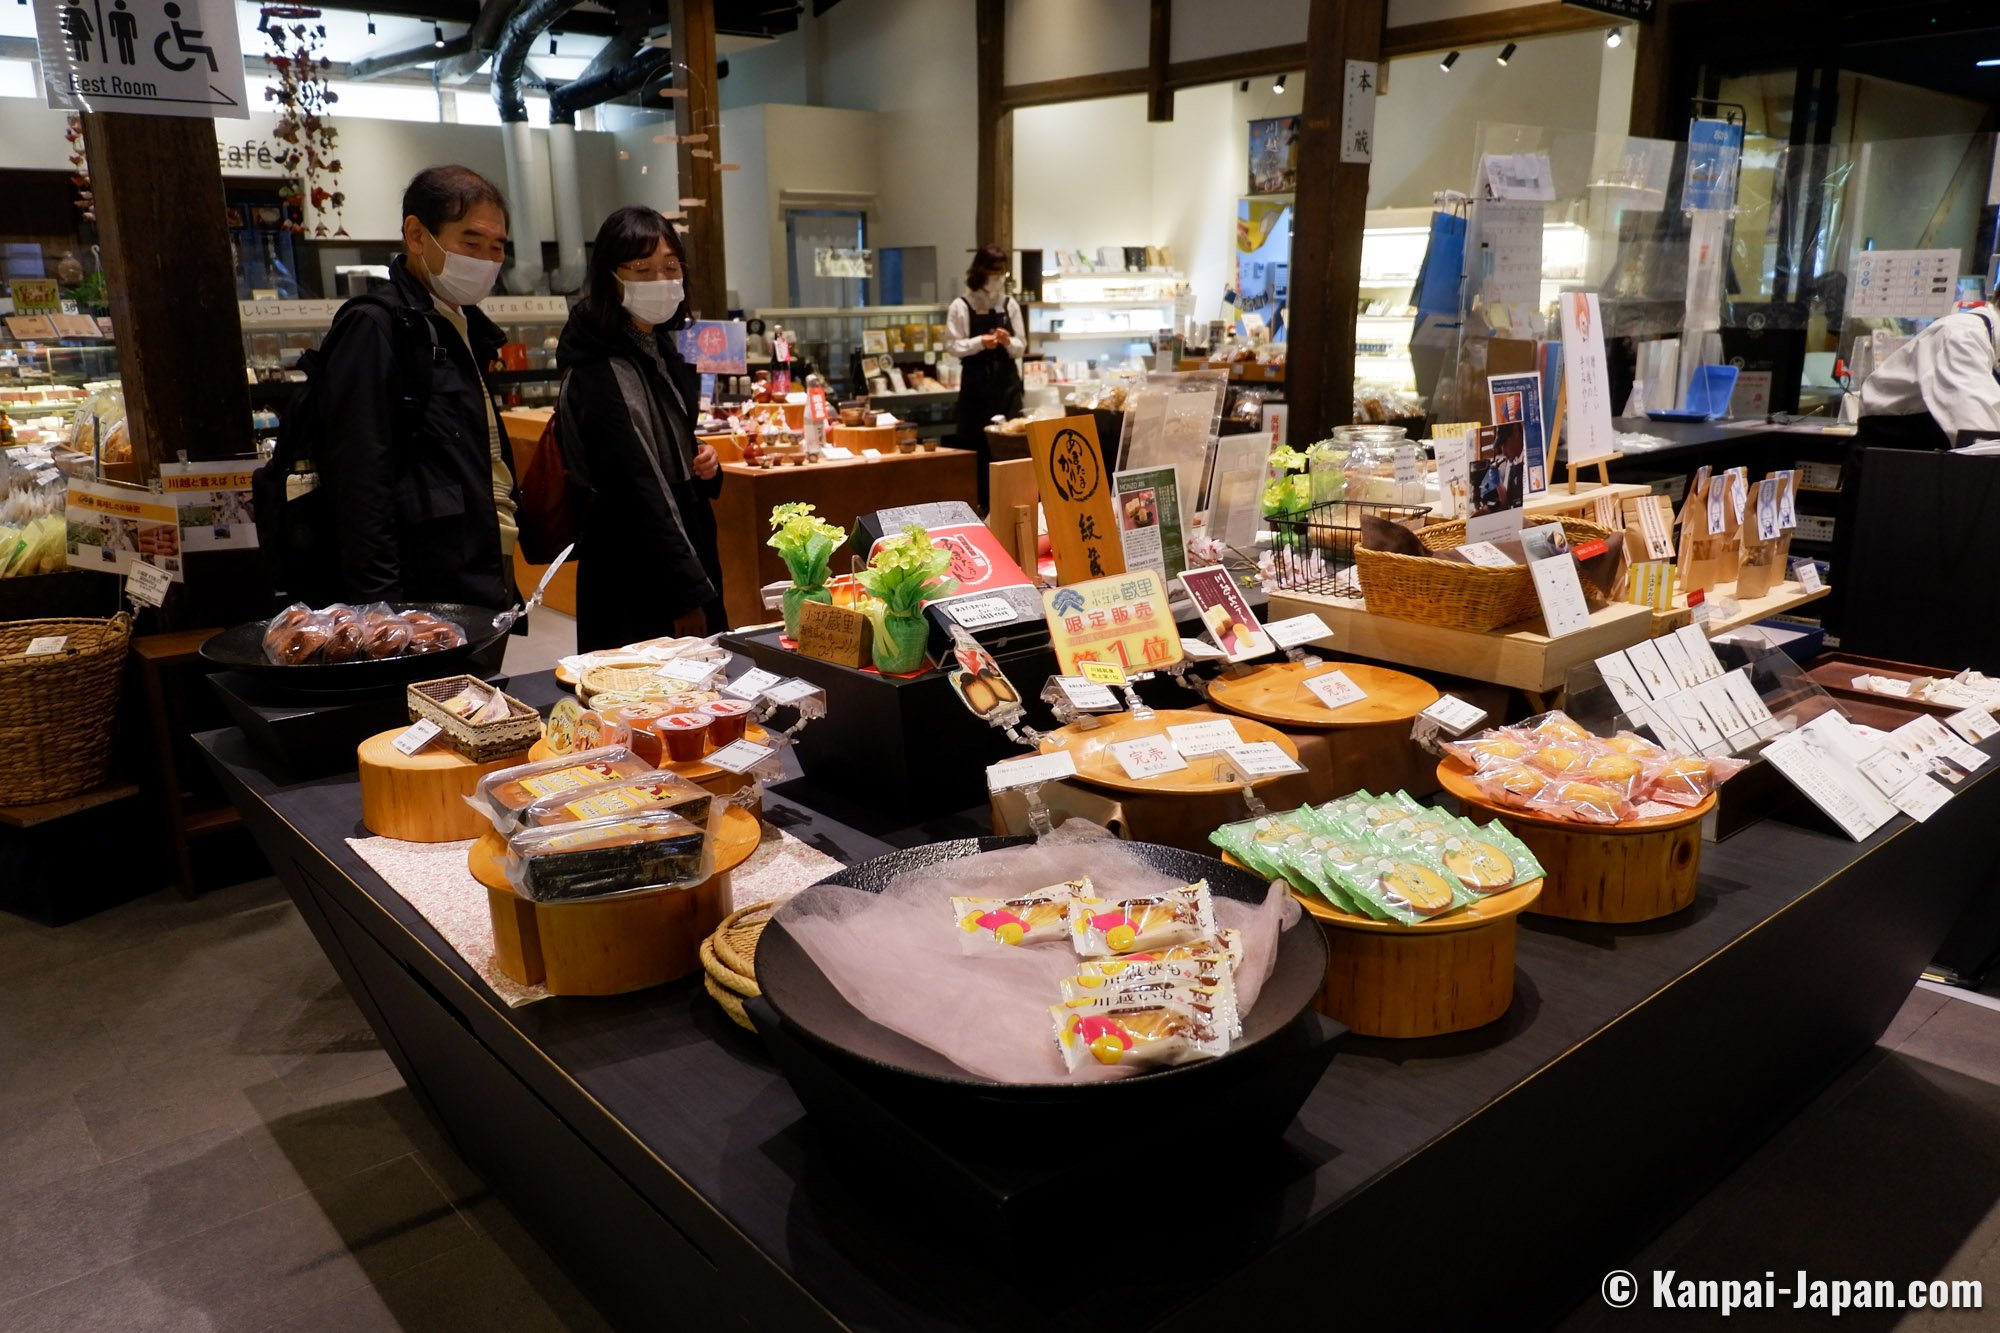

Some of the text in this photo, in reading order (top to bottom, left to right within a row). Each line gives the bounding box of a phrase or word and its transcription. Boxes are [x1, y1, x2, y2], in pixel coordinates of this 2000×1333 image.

[112, 76, 157, 97] Room
[1064, 602, 1153, 633] 限定販売
[1129, 746, 1168, 766] 完売
